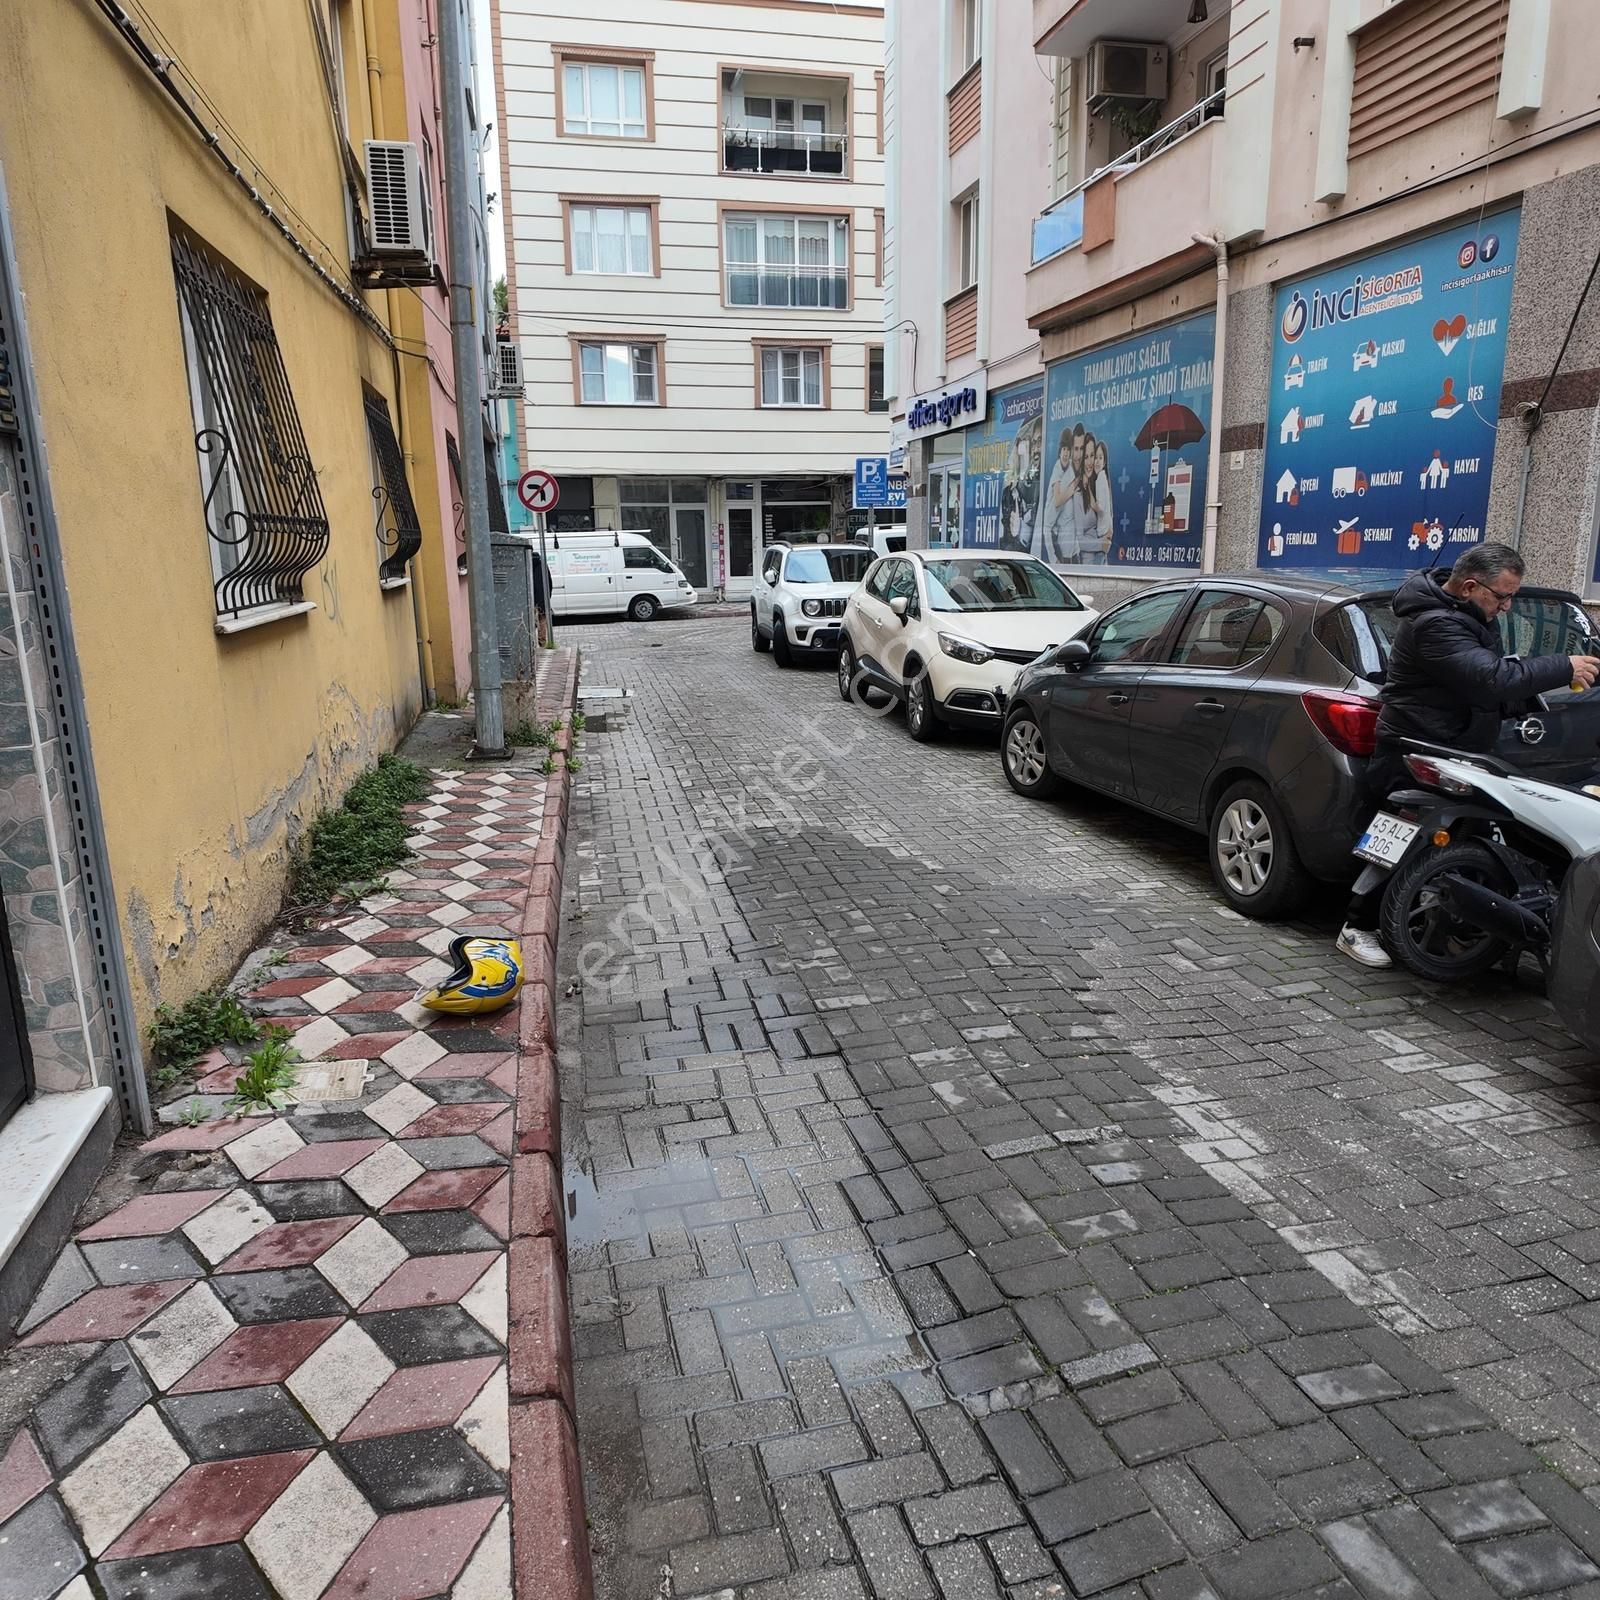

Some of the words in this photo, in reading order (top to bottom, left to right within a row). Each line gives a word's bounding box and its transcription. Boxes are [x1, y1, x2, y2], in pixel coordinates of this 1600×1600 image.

[1466, 319, 1497, 339] SAĞLIK
[1381, 339, 1405, 357] KASKO
[1084, 351, 1137, 386] TAMAMLAYICI
[1139, 340, 1171, 371] SAĞLIK
[1308, 356, 1328, 373] TRAFİK
[1051, 394, 1086, 421] SİGORTASI
[1087, 388, 1100, 412] İLE
[1101, 376, 1147, 410] SAĞLIĞINIZ
[1149, 365, 1178, 403] ŞİMDİ
[1468, 386, 1484, 401] BES
[908, 399, 937, 430] ethica
[1378, 400, 1398, 416] DASK
[1304, 414, 1325, 428] KONUT
[1454, 458, 1480, 474] HAYAT
[1301, 477, 1319, 496] İŞYERİ
[1371, 470, 1403, 487] NAKLİYAT
[975, 481, 986, 509] EN
[988, 474, 999, 508] İYİ
[976, 510, 997, 543] FİYAT
[1364, 528, 1393, 542] SEYAHAT
[1448, 526, 1479, 542] TARSİM
[1286, 531, 1302, 545] FERDİ
[1303, 533, 1317, 545] KAZA
[1136, 547, 1144, 561] 24
[1158, 547, 1173, 562] 0541
[1174, 547, 1186, 562] 672
[1187, 547, 1195, 562] 47
[1373, 816, 1390, 833] 45
[1387, 822, 1415, 843] ALZ
[1368, 836, 1394, 855] 306
